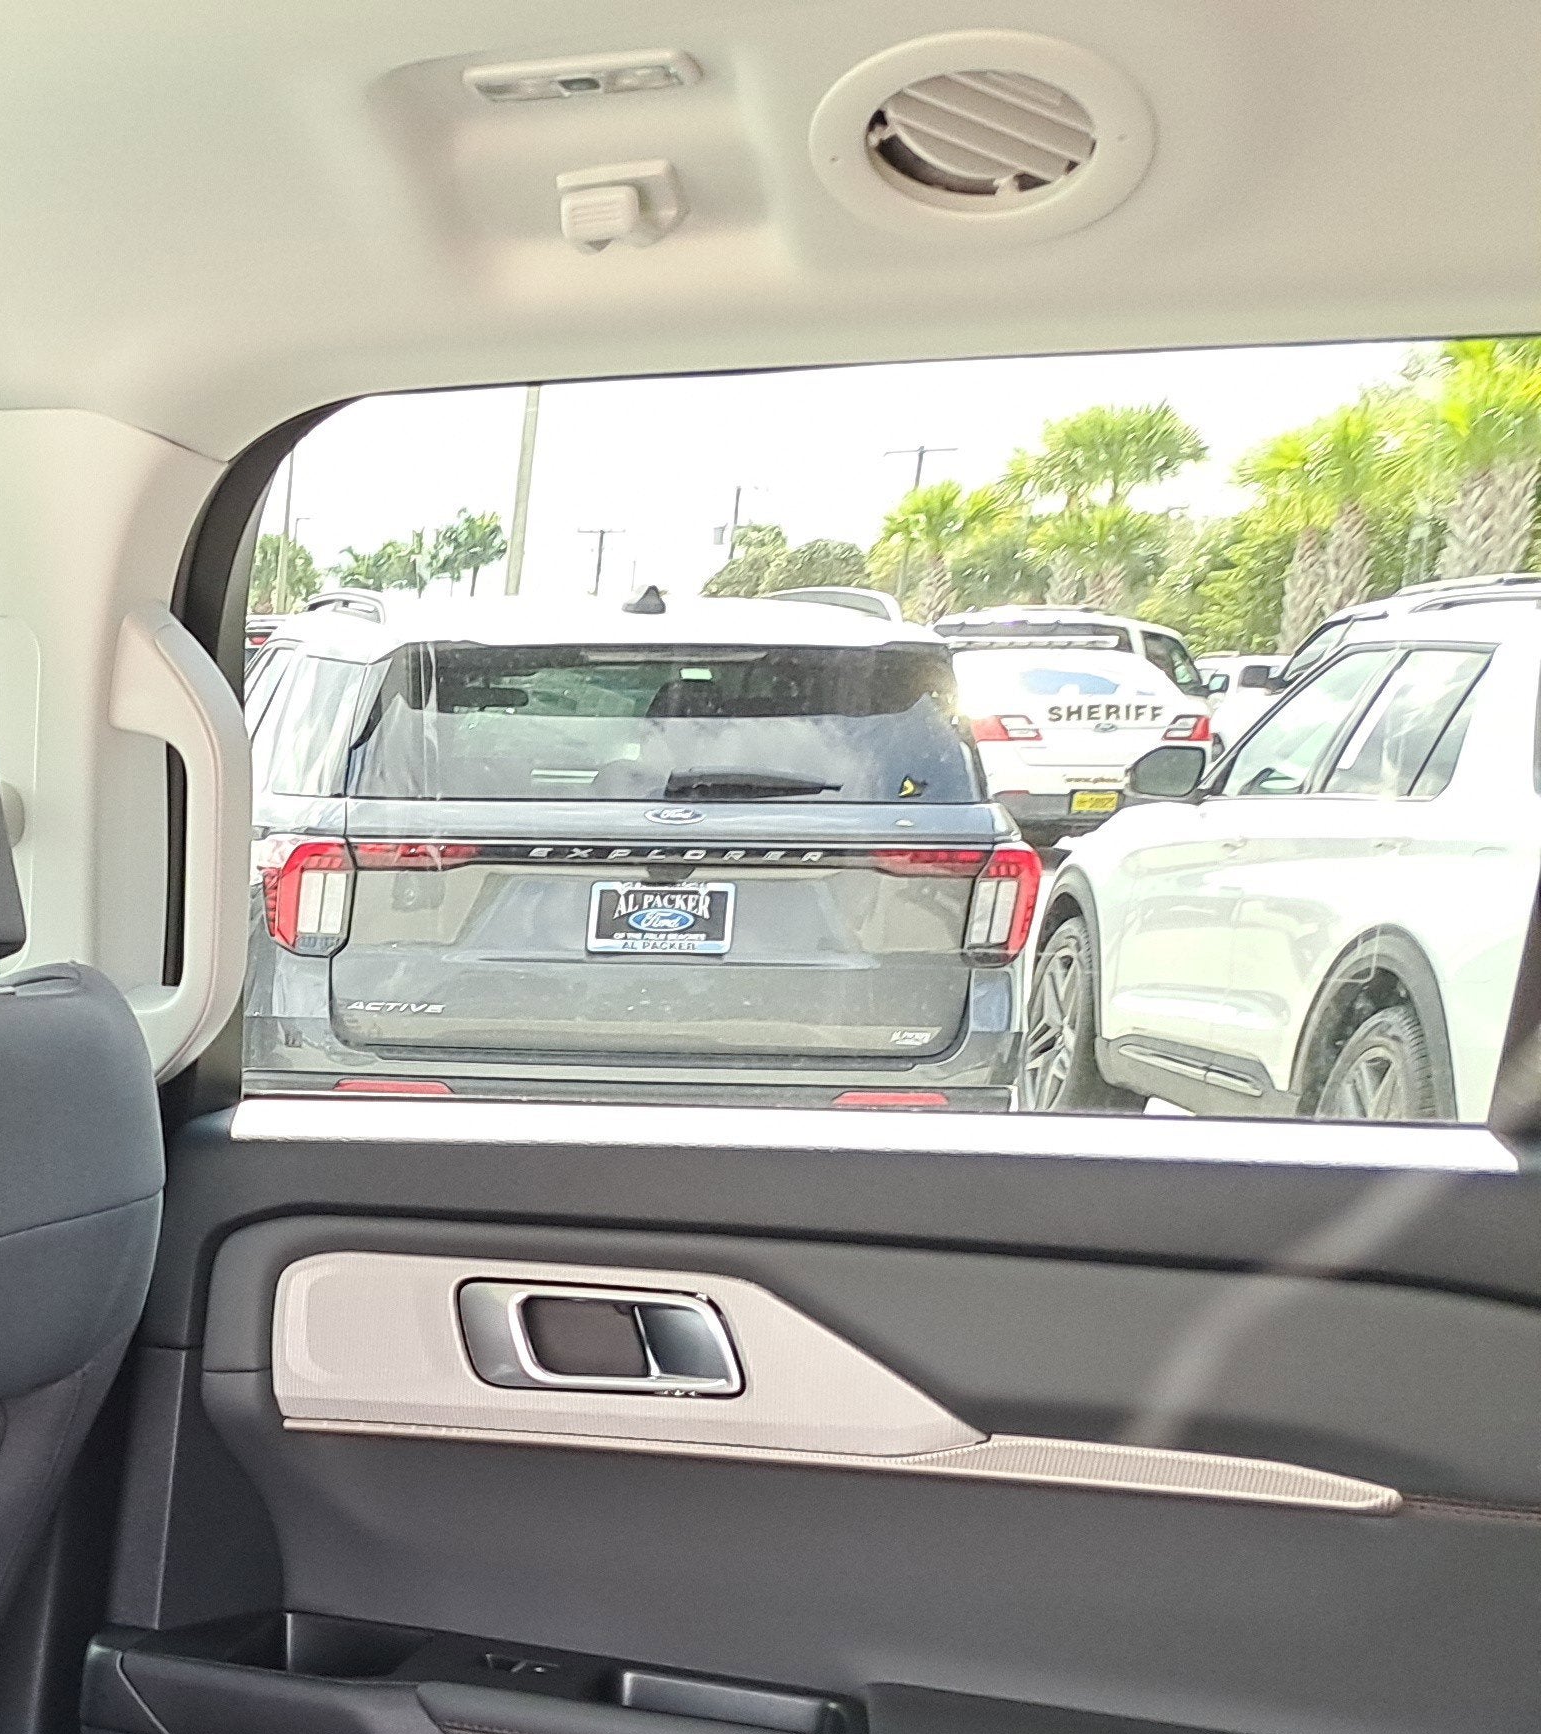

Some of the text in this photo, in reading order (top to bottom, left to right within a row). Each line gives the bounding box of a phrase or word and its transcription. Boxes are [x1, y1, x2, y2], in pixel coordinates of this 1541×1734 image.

[1048, 704, 1163, 722] SHERIFF
[529, 847, 824, 862] EXPLORER
[613, 893, 711, 919] AL PACKER
[639, 910, 682, 929] Ford
[621, 941, 698, 950] AL PACKER
[347, 1001, 447, 1014] ACTIVE
